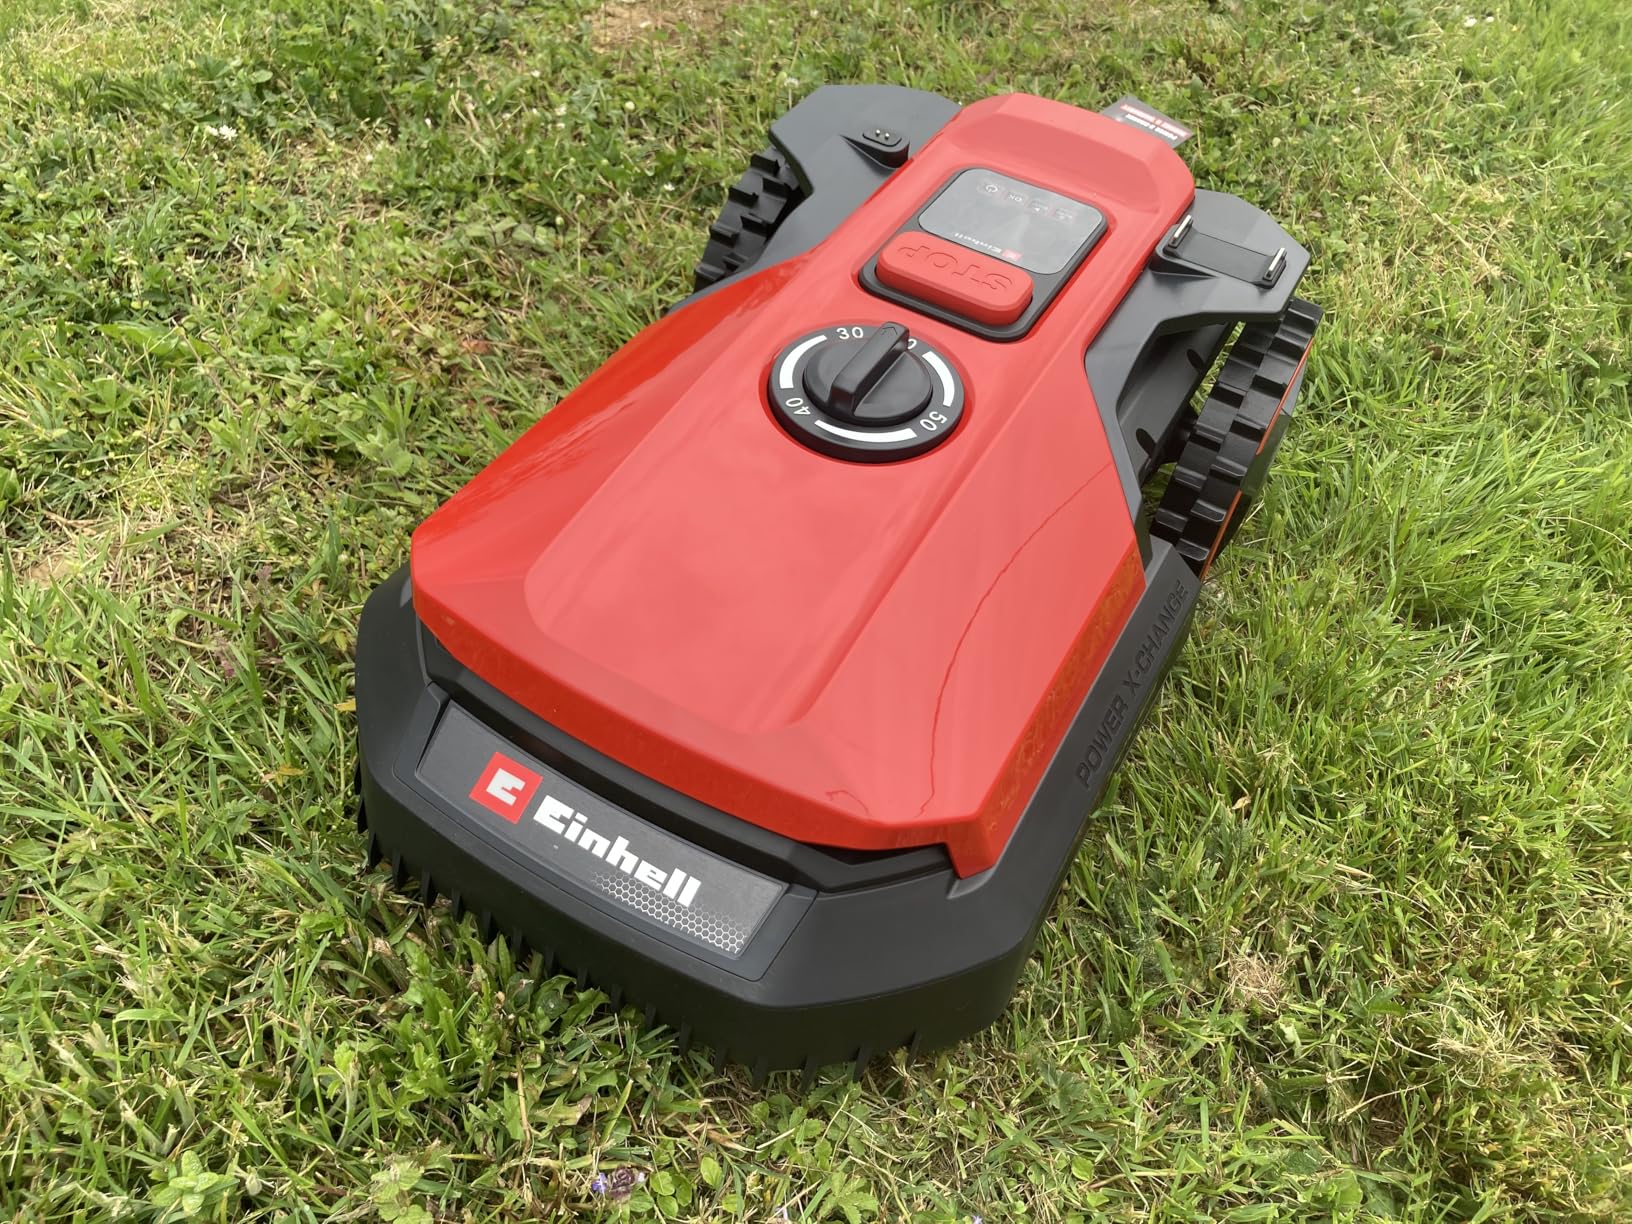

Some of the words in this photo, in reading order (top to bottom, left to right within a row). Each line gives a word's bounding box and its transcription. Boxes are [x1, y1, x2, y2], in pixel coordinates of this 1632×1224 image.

[1008, 193, 1023, 204] OK
[897, 244, 1014, 290] STOP
[835, 325, 865, 340] 30
[785, 397, 812, 417] 40
[919, 411, 948, 432] 50
[1075, 695, 1129, 789] POWER
[1122, 579, 1189, 697] X-CHANGE
[532, 794, 702, 908] Einhell
